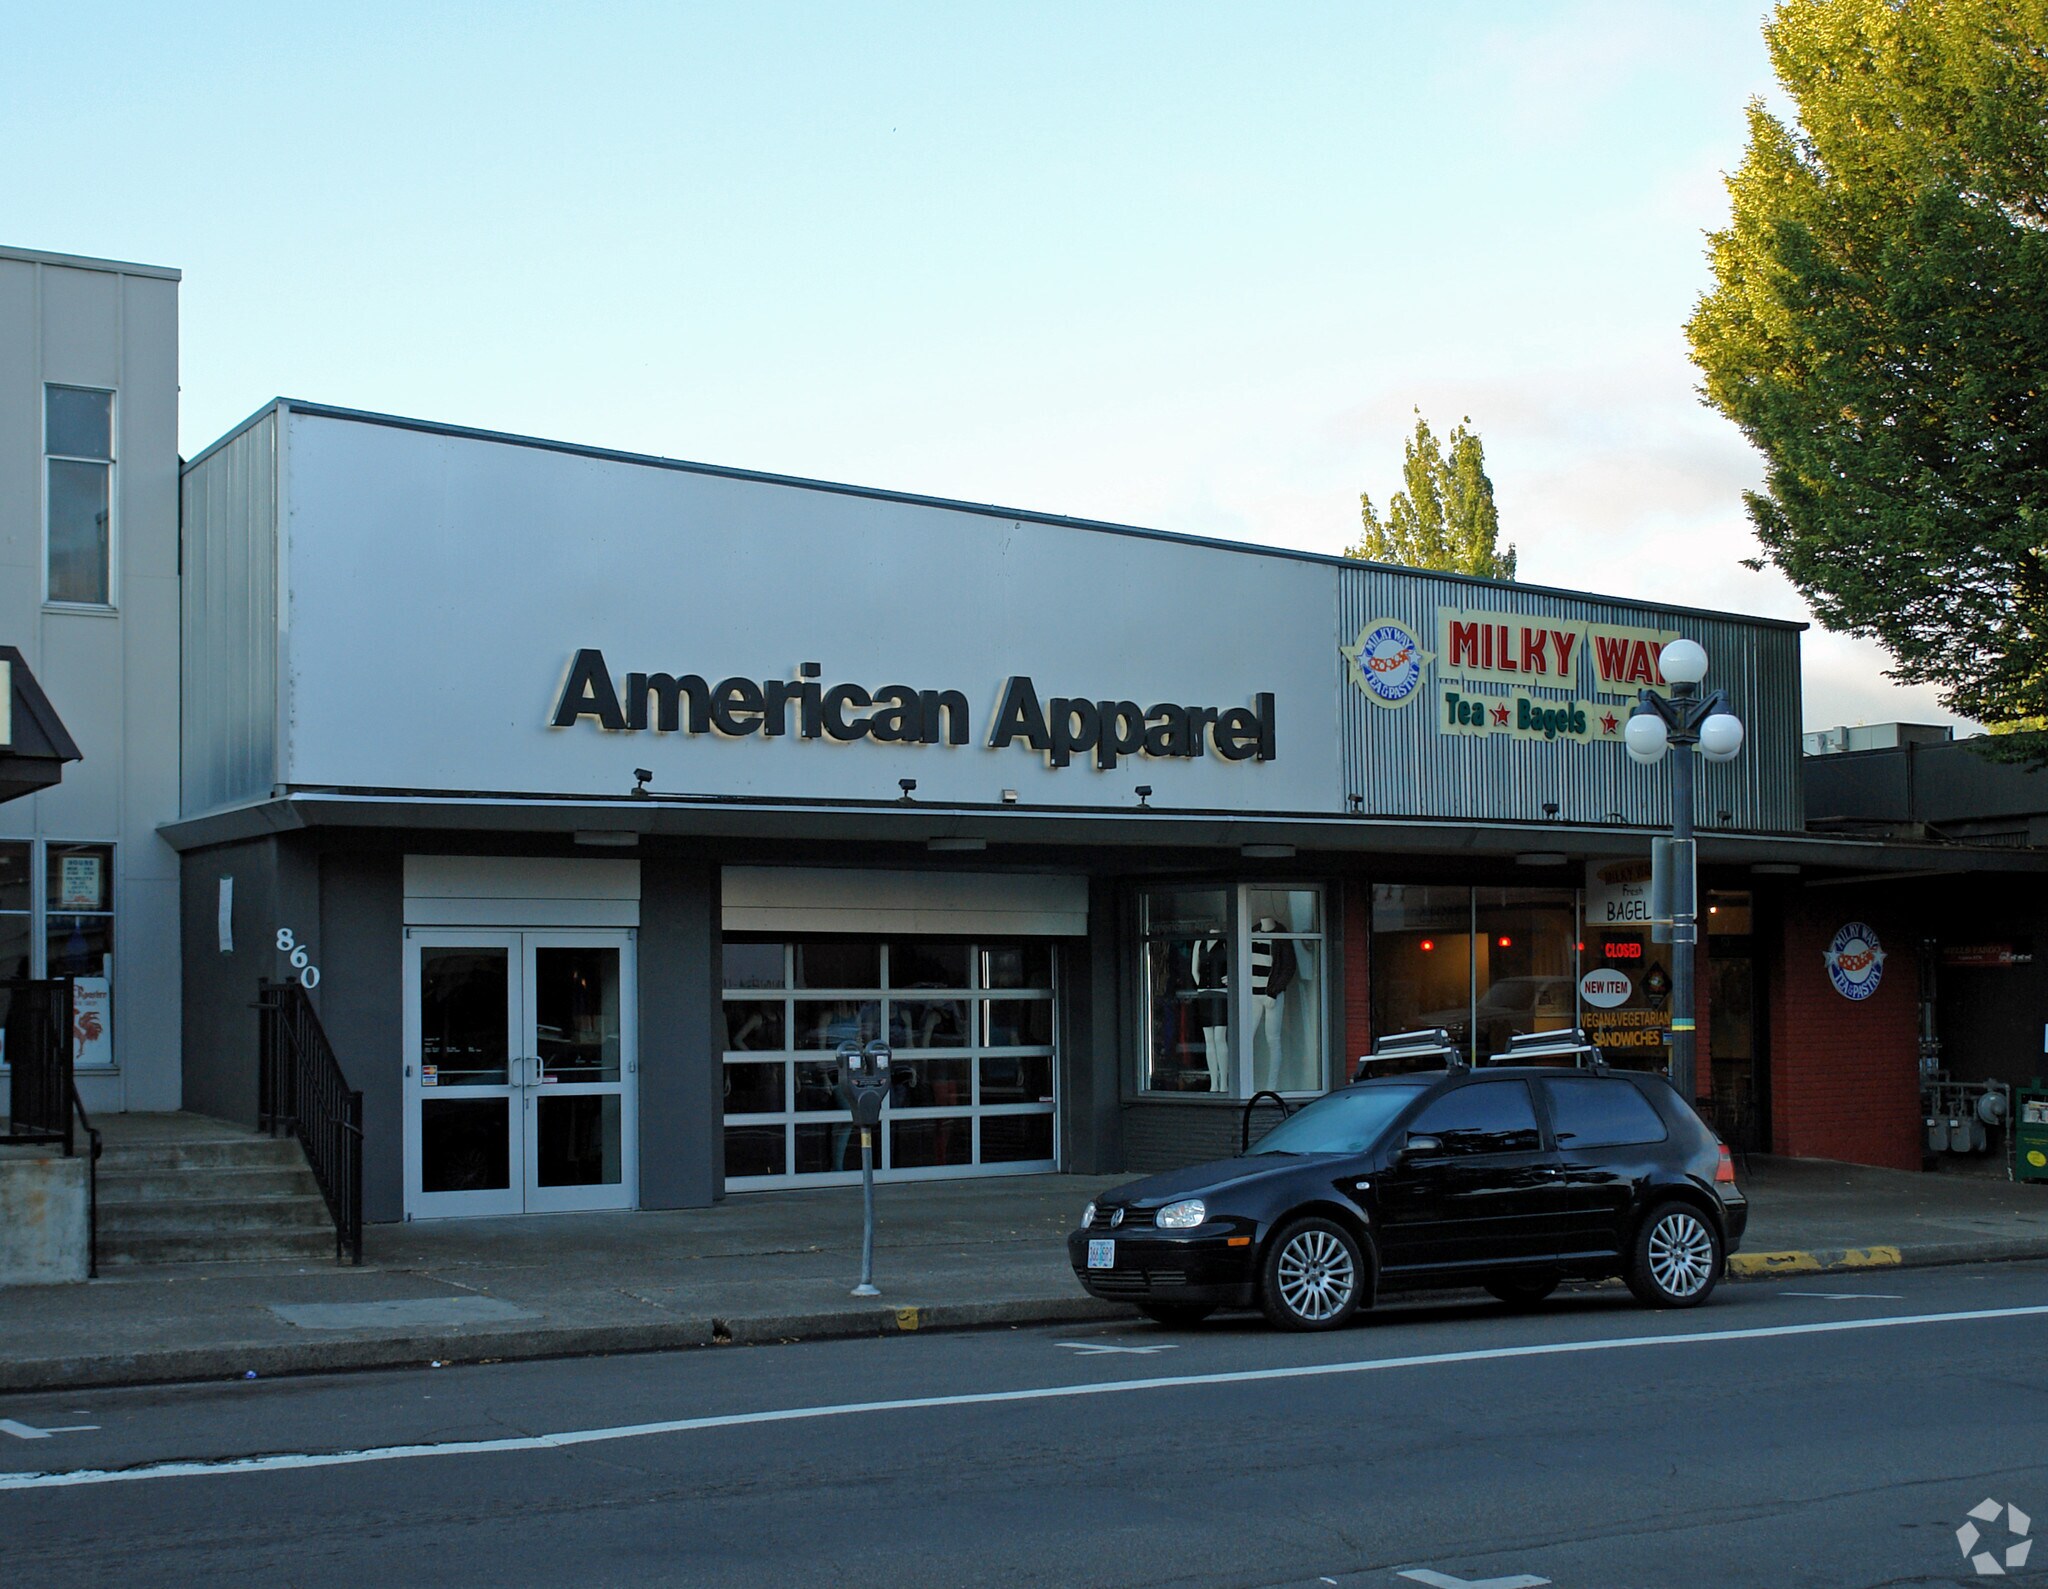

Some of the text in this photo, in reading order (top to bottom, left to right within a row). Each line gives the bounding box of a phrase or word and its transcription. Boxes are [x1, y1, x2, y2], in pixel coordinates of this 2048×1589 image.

[1365, 627, 1414, 653] MILKY WAY
[1449, 620, 1576, 677] MILKY
[551, 648, 1276, 770] American Apparel
[1445, 692, 1587, 740] Tea Bagels
[1622, 884, 1644, 897] Fresh
[1835, 924, 1879, 948] MILKY WAY
[276, 927, 320, 989] 860
[1605, 942, 1642, 958] CLOSED
[1584, 981, 1628, 994] NEW ITEM
[1592, 1030, 1660, 1048] SANDWICHES
